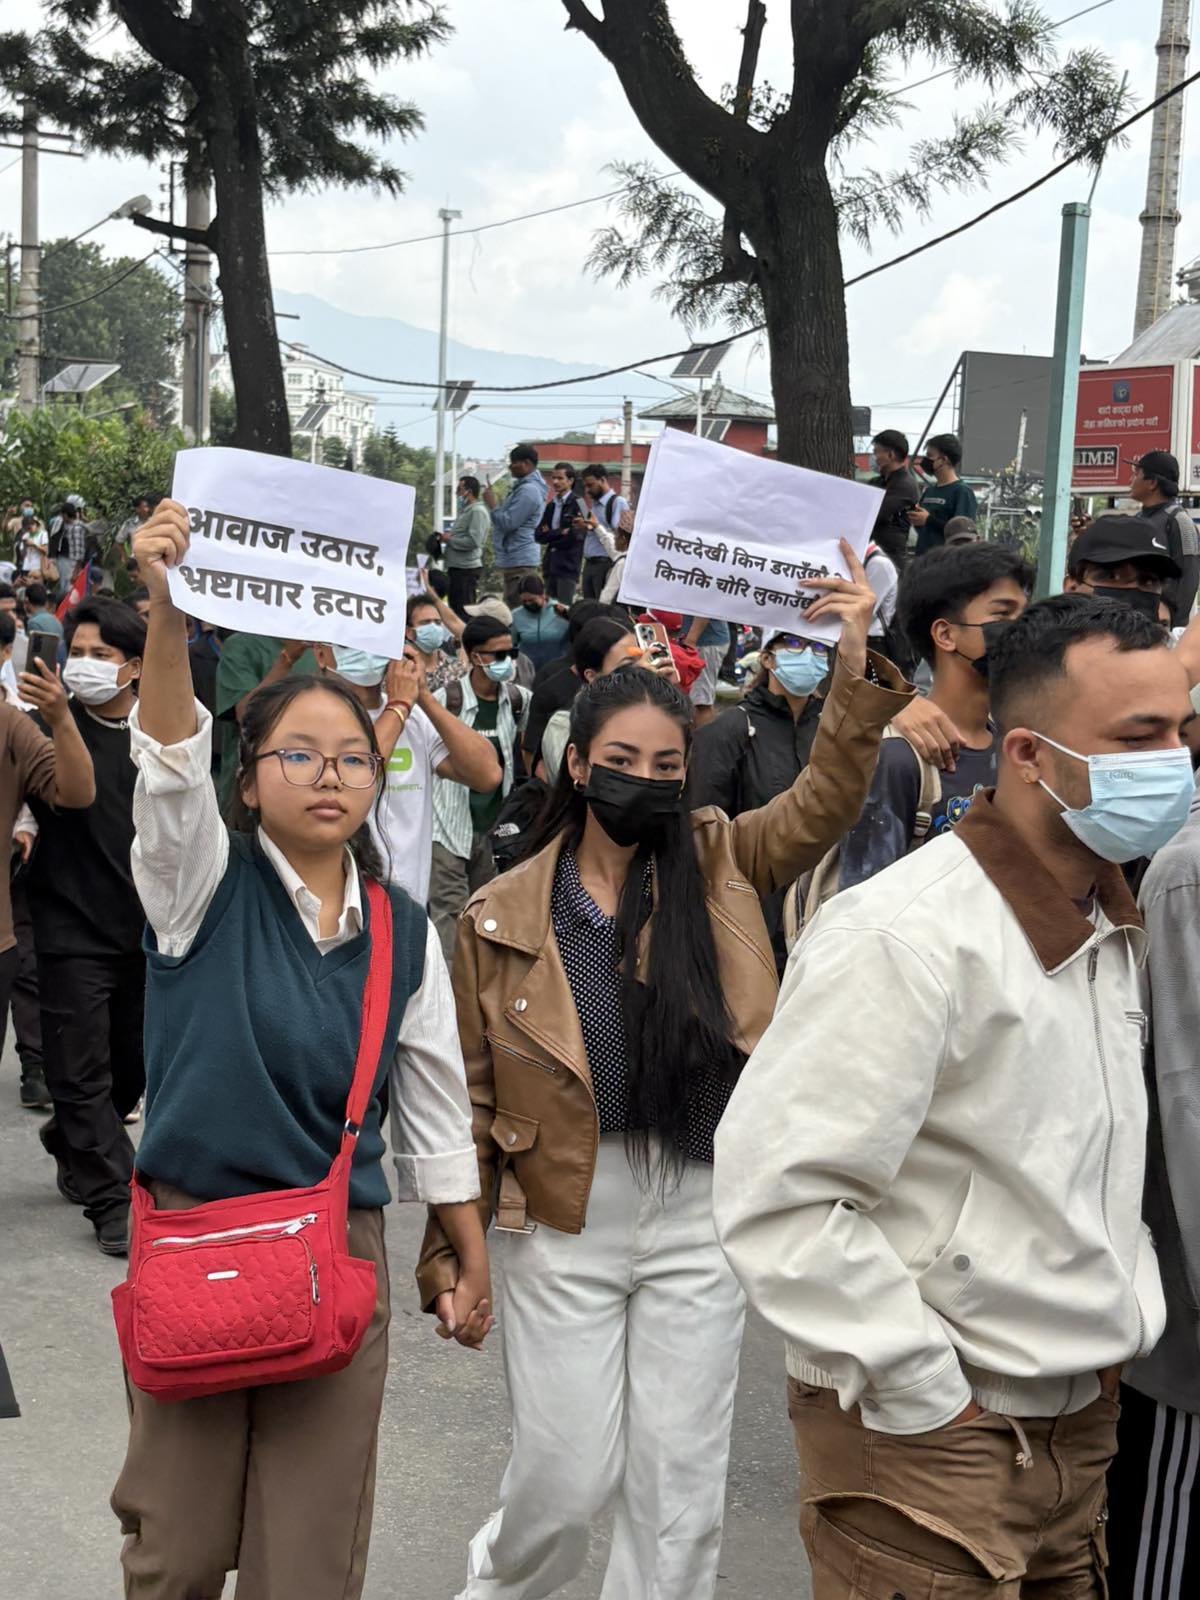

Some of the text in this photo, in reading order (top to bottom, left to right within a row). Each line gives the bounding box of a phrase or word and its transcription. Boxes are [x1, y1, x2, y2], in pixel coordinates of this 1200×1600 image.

[1081, 450, 1115, 466] IME
[187, 507, 295, 554] आवाज
[300, 530, 384, 577] उठाउ,
[656, 530, 729, 563] पोस्टदेखी
[732, 547, 767, 572] किन
[179, 565, 387, 624] भ्रष्टाचार हटाउ
[654, 559, 712, 589] किनकि
[716, 574, 750, 597] चोरि
